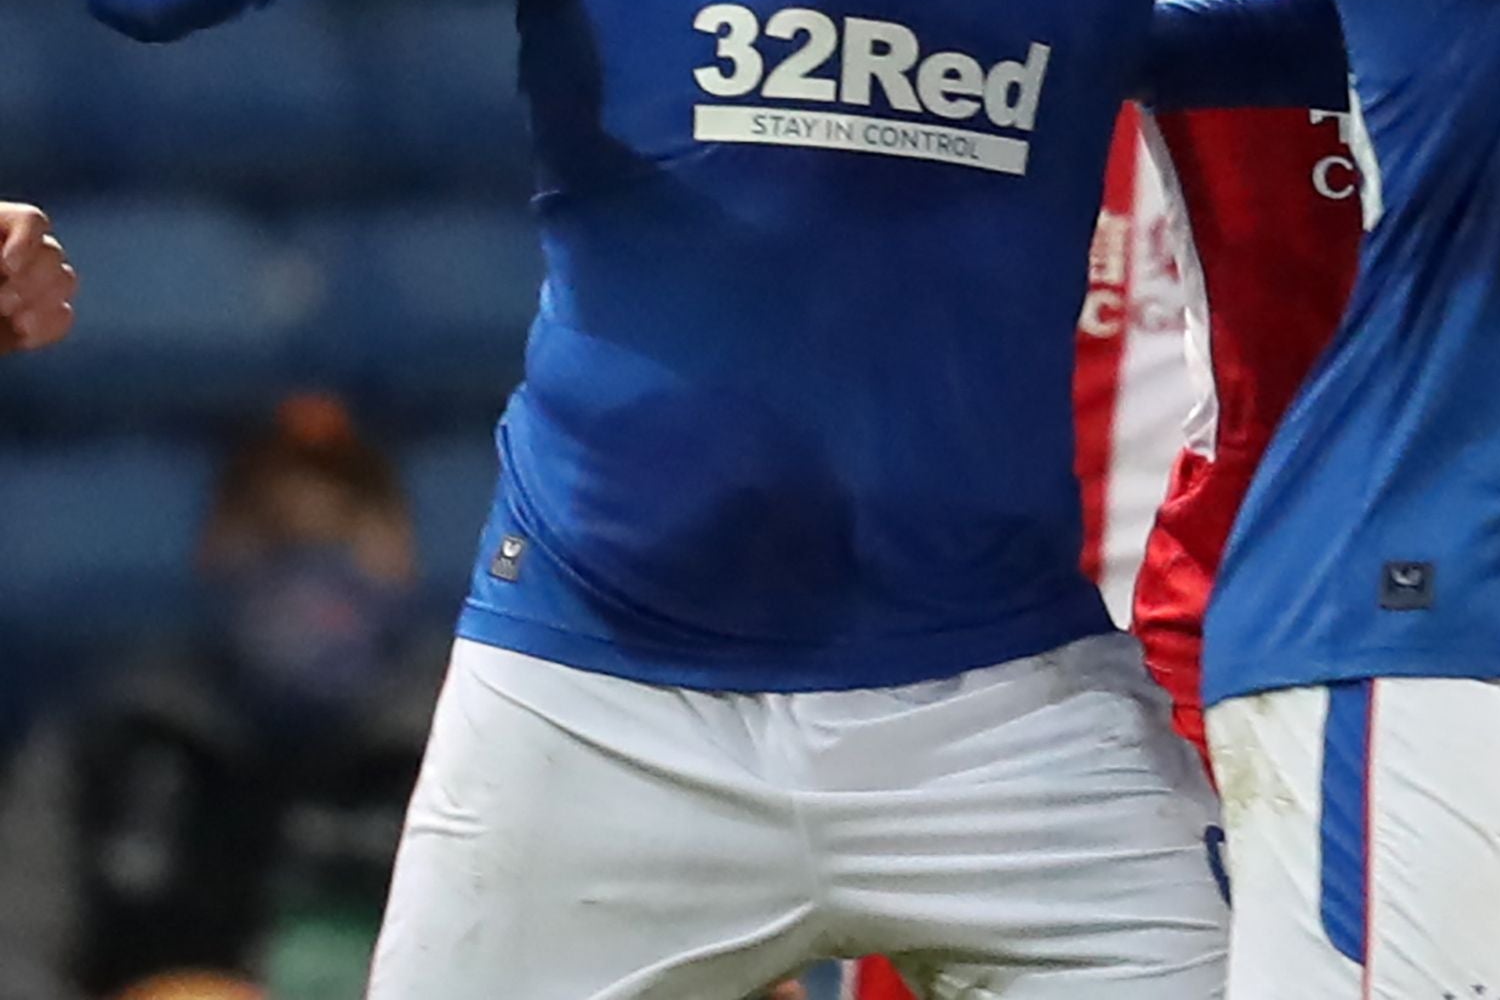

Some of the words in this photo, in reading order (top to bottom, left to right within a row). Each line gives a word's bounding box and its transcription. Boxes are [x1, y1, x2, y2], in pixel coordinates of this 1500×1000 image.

[692, 3, 1052, 131] 32Red
[752, 114, 820, 139] STAY
[826, 118, 853, 142] IN
[863, 124, 980, 160] CONTROL
